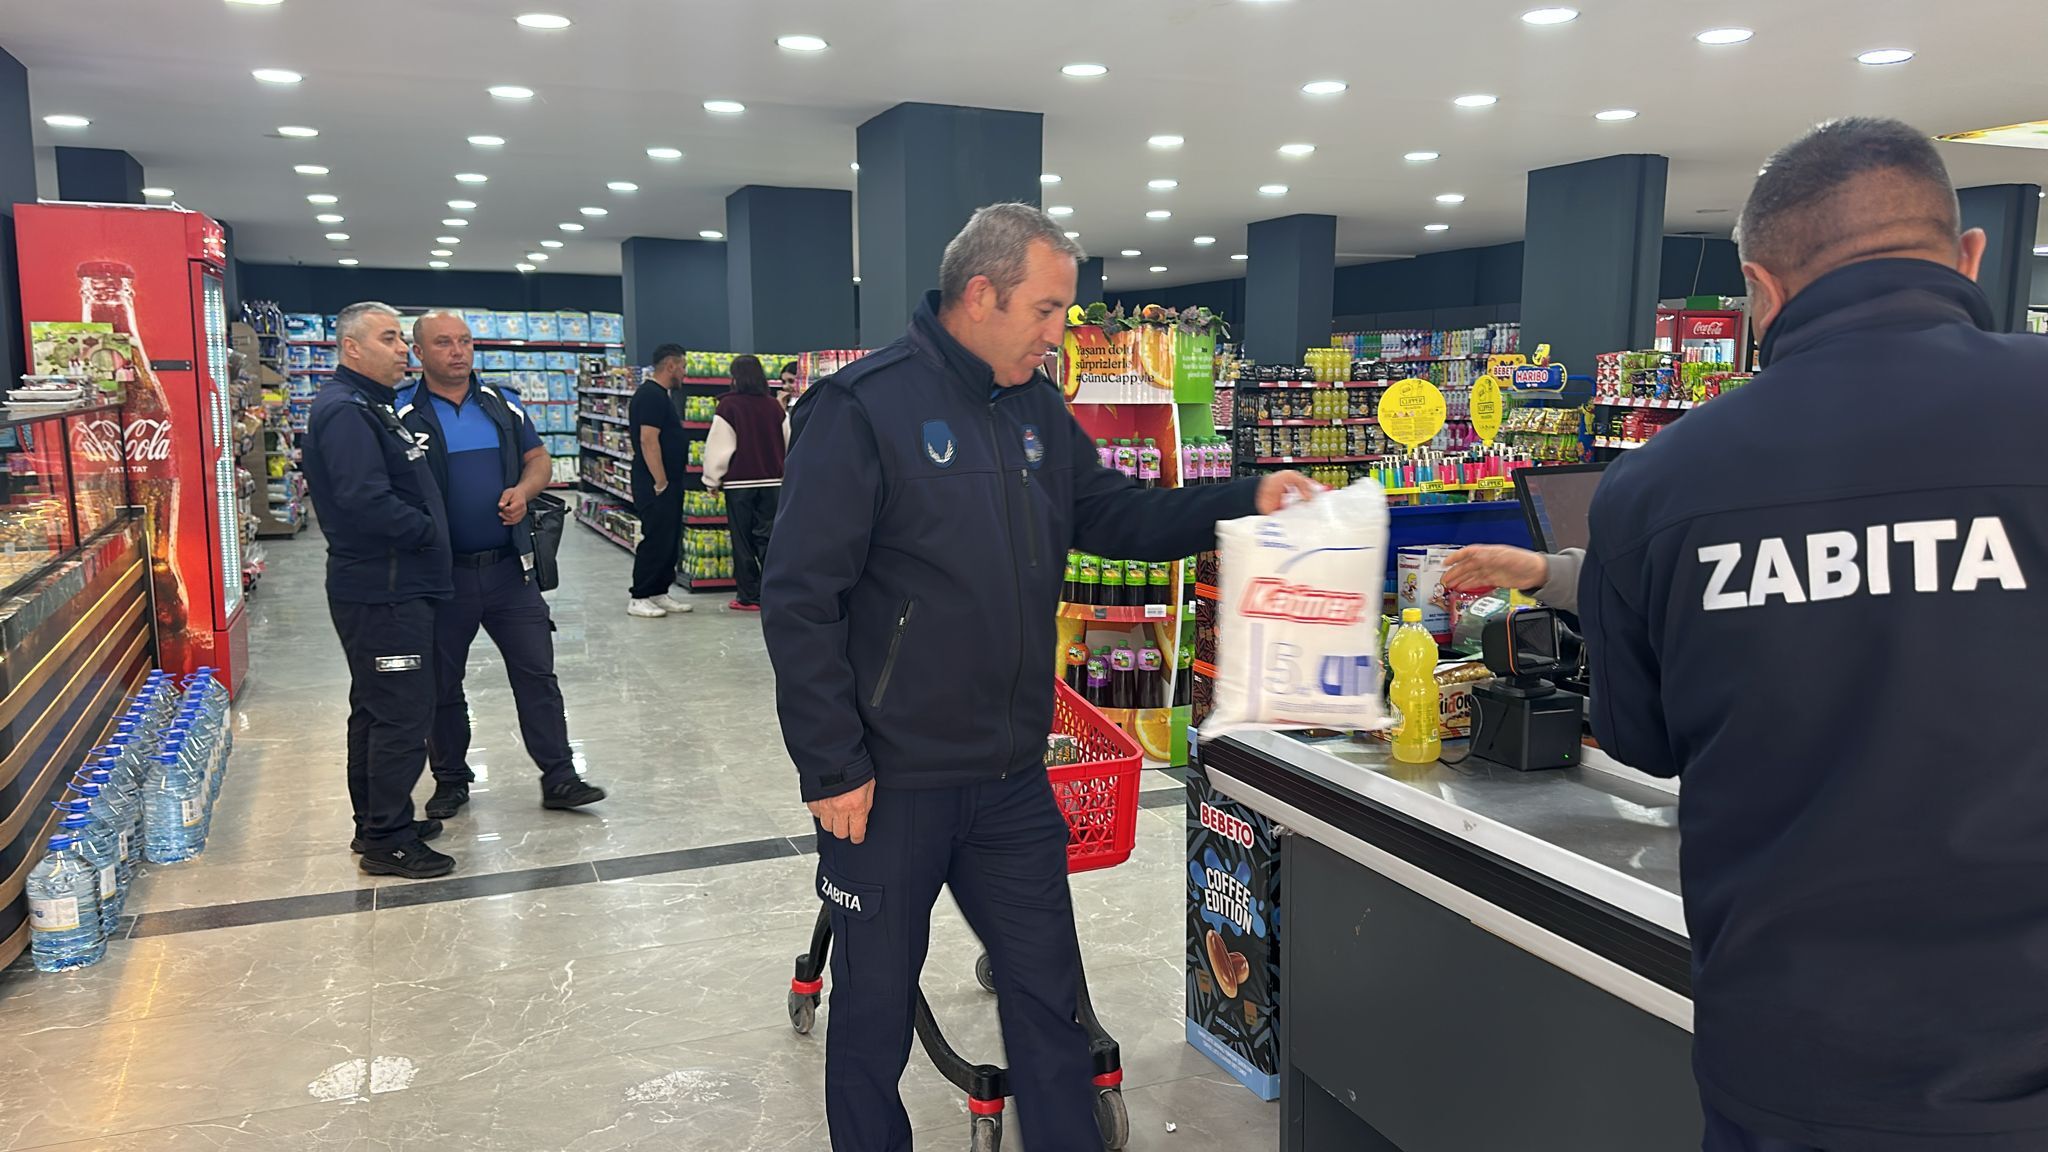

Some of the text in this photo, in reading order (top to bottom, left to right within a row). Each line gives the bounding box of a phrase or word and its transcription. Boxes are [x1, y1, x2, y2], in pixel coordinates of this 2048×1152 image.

[1075, 345, 1107, 357] Yaşam
[1493, 366, 1516, 376] BEBET
[1516, 370, 1548, 383] HARIBO
[1698, 516, 2027, 611] ZABITA
[1201, 803, 1253, 848] BEBETO
[822, 876, 861, 912] ZABITA
[1206, 868, 1251, 911] COFFEE
[1205, 888, 1252, 935] EDITION
